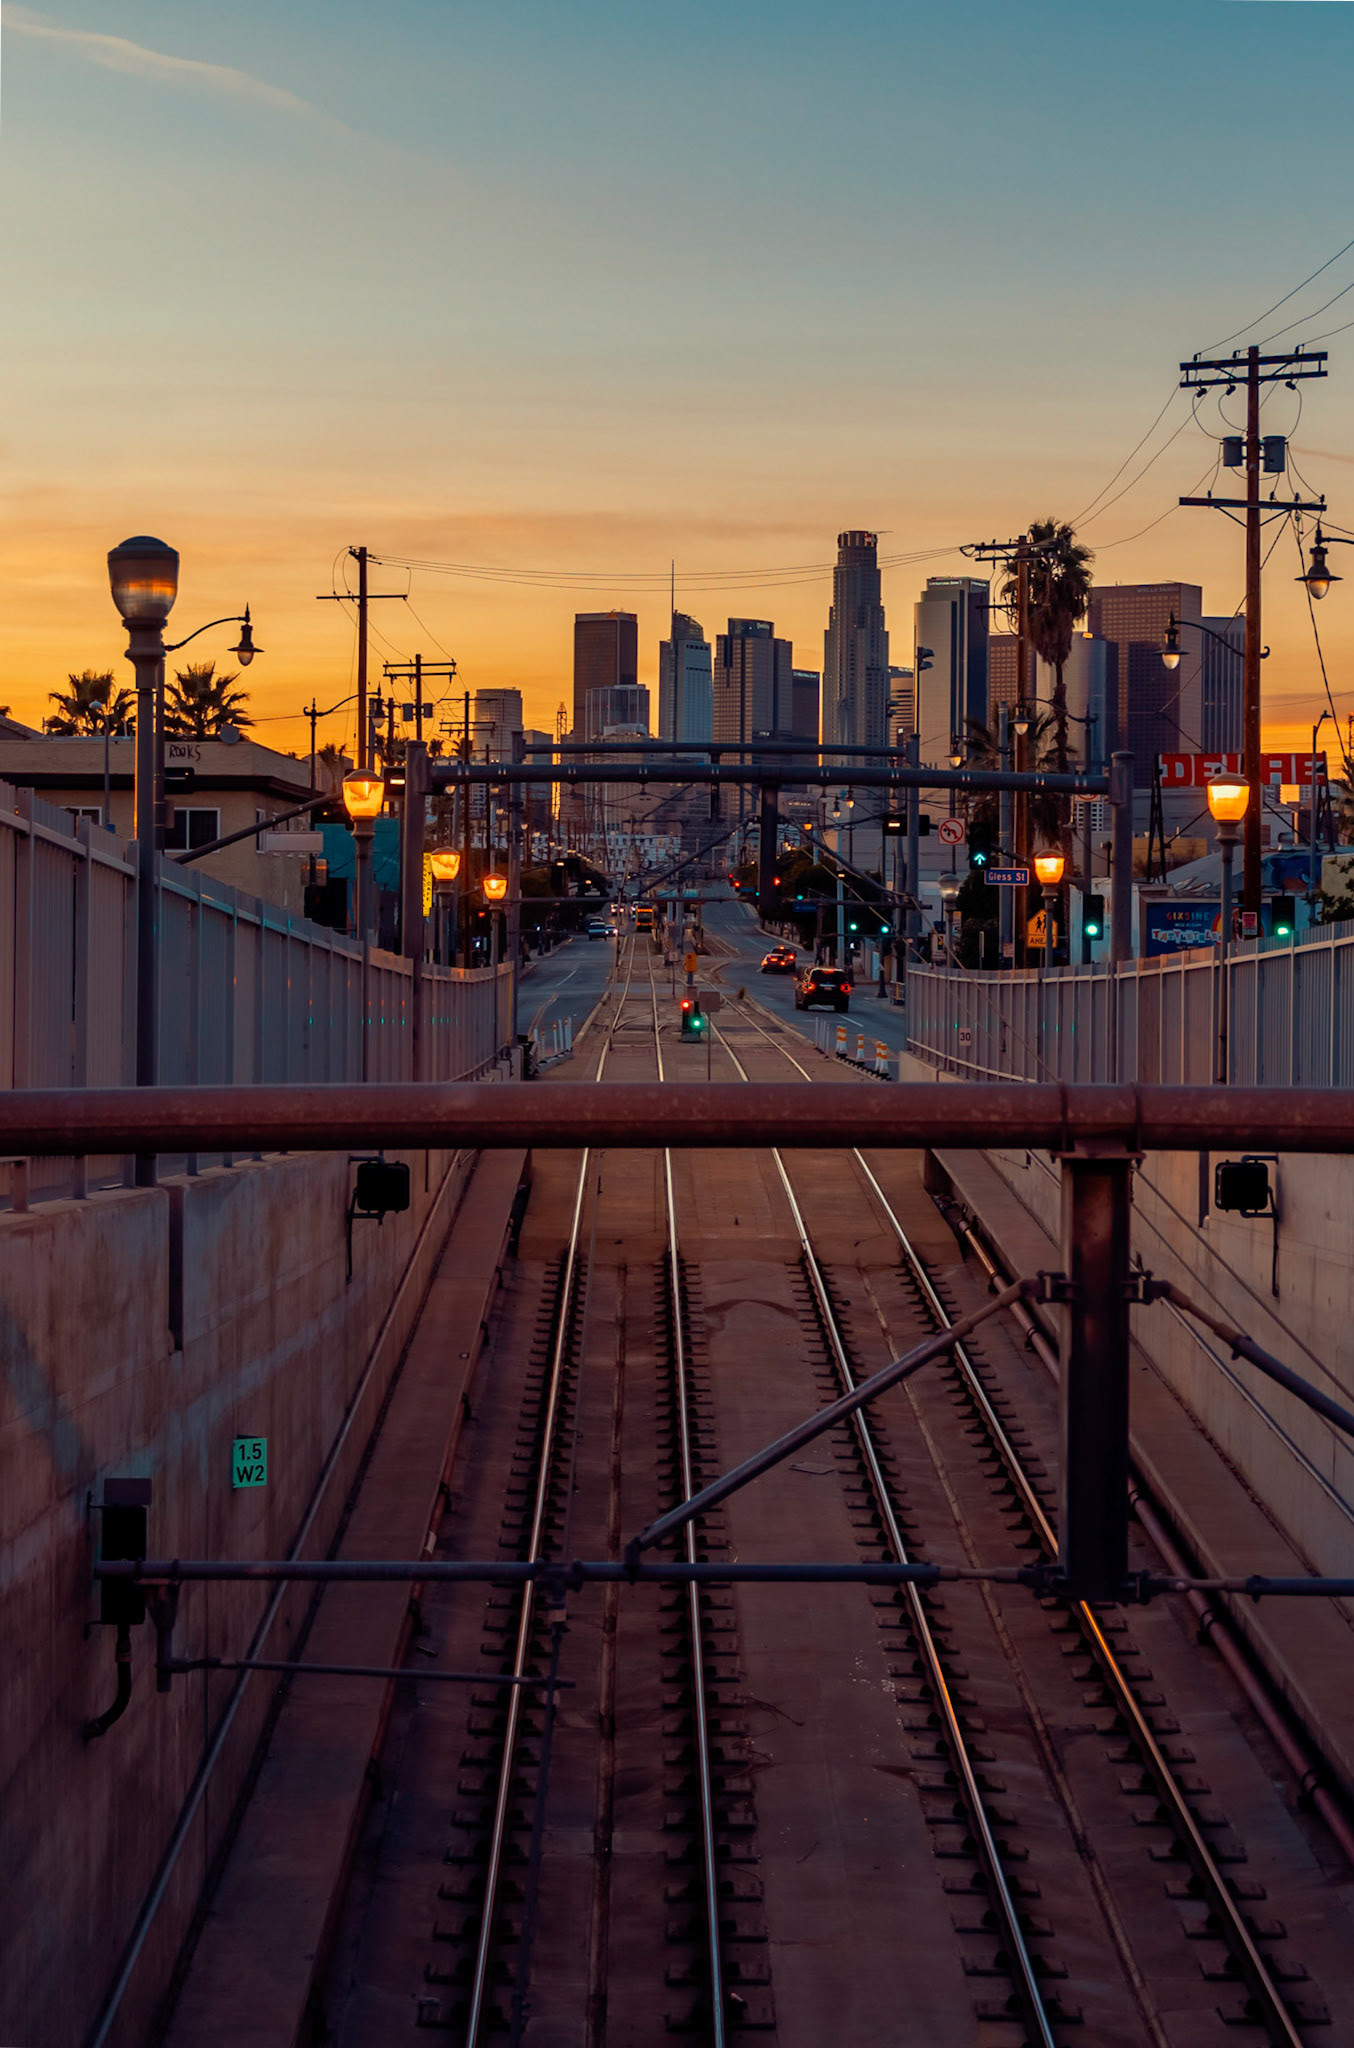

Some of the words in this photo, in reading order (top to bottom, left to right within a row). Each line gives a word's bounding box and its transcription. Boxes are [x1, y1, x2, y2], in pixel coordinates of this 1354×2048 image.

[988, 872, 1012, 881] Gless
[1015, 872, 1025, 881] St
[960, 1032, 971, 1041] 30
[238, 1443, 262, 1461] 1.5
[236, 1465, 264, 1483] W2
